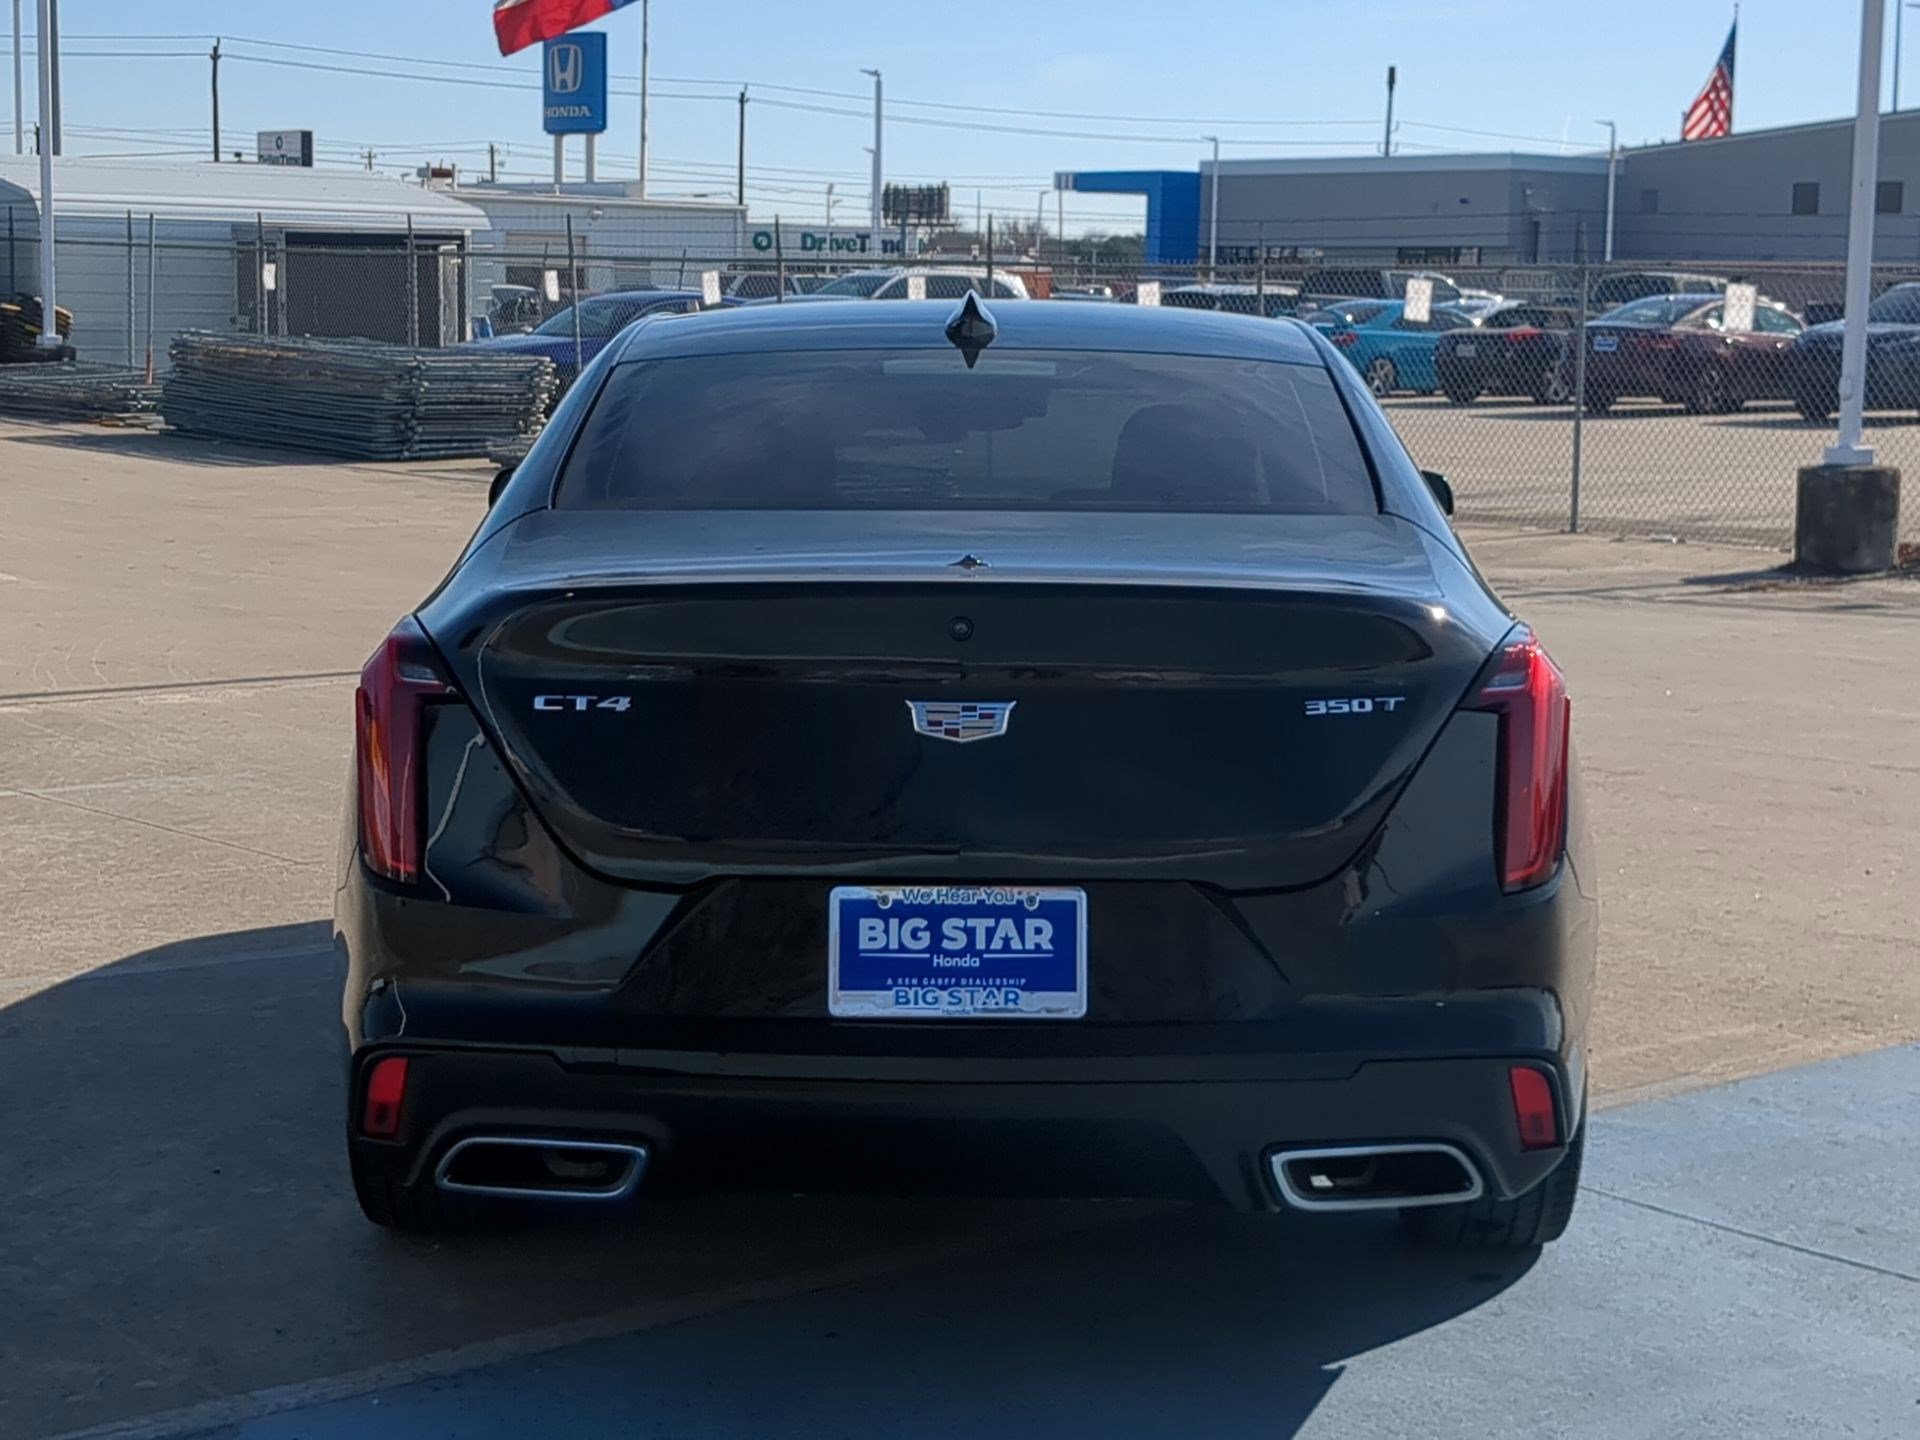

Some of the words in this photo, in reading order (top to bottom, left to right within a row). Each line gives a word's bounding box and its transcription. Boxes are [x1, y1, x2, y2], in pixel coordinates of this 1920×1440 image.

[544, 105, 592, 118] HONDA
[534, 695, 631, 711] CT4
[1304, 697, 1406, 715] 350T
[902, 888, 932, 903] We
[936, 888, 979, 903] Hear
[983, 888, 1015, 903] You
[858, 918, 931, 950] BIG
[942, 918, 1054, 950] STAR
[933, 954, 980, 967] Honda
[895, 988, 939, 1006] BIG
[947, 988, 1020, 1006] STAR
